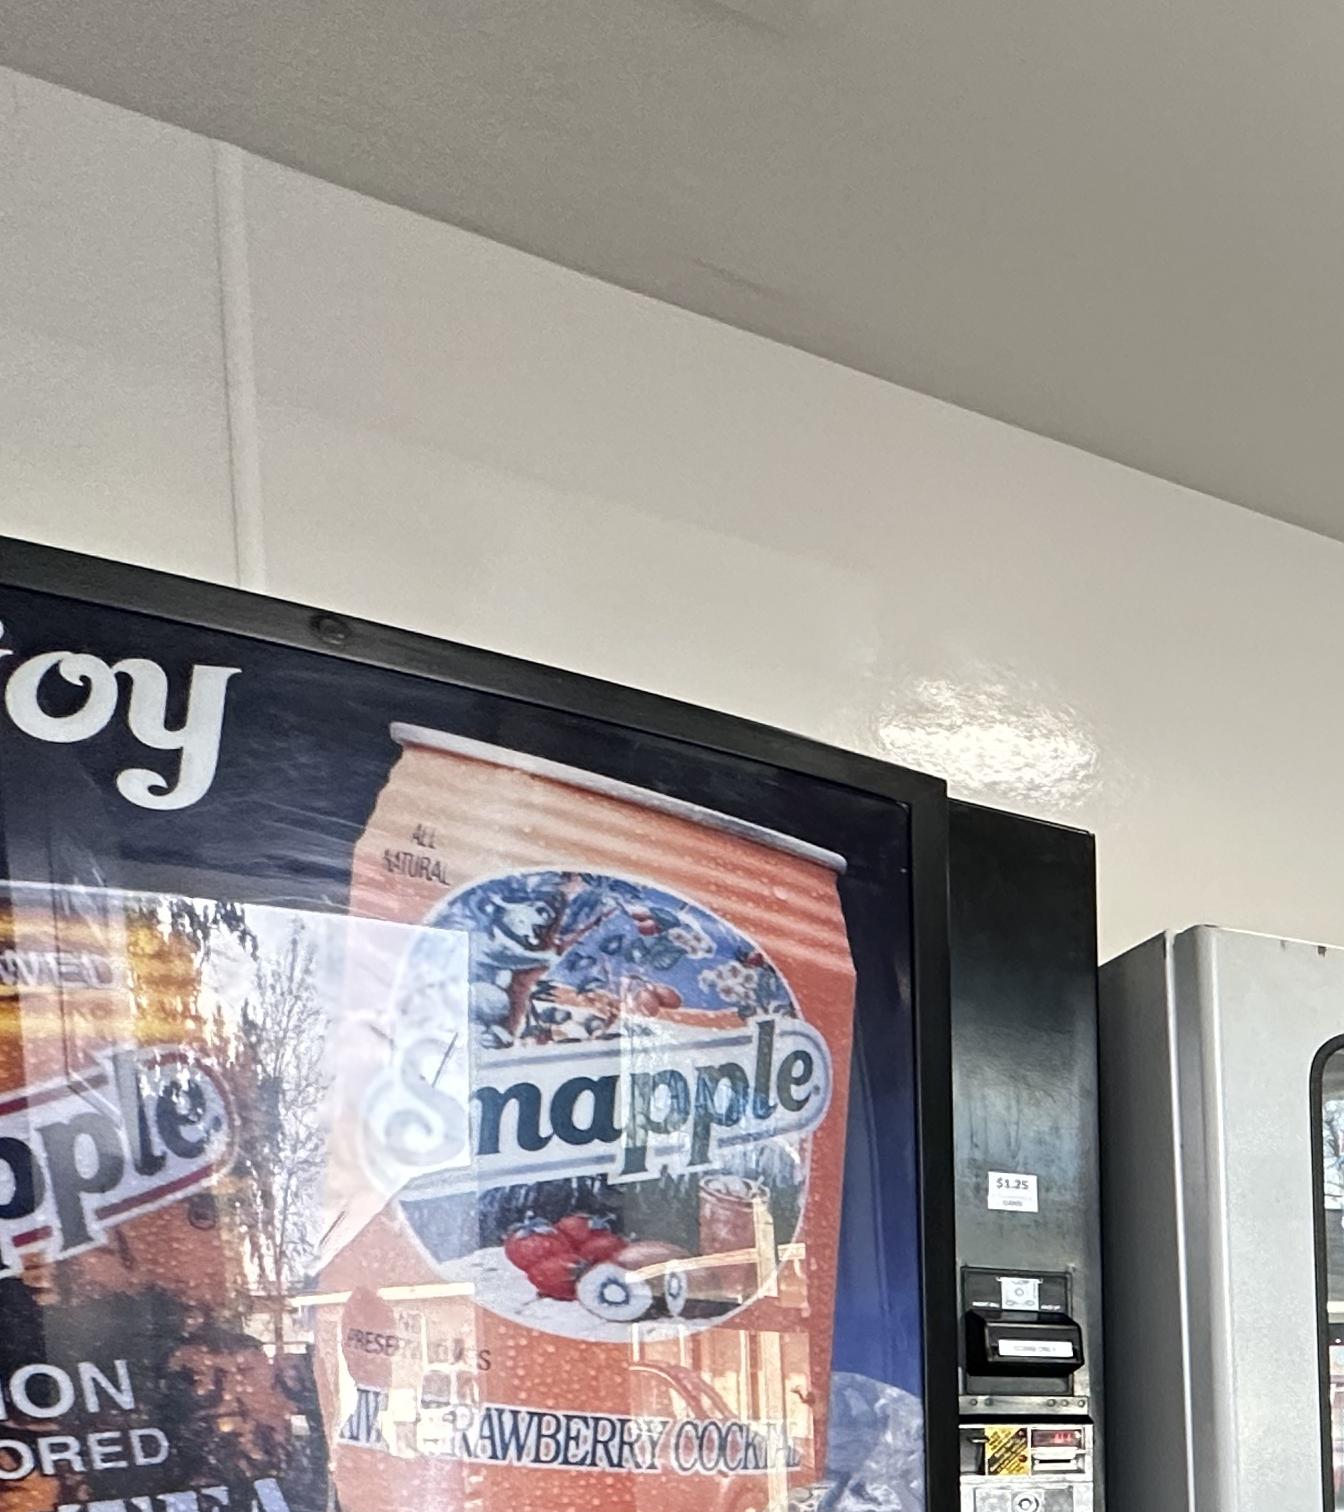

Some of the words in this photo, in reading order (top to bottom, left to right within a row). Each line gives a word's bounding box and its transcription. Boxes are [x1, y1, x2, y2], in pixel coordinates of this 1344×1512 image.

[0, 630, 241, 811] oy
[372, 1019, 816, 1175] Snapple
[0, 1360, 135, 1421] ON
